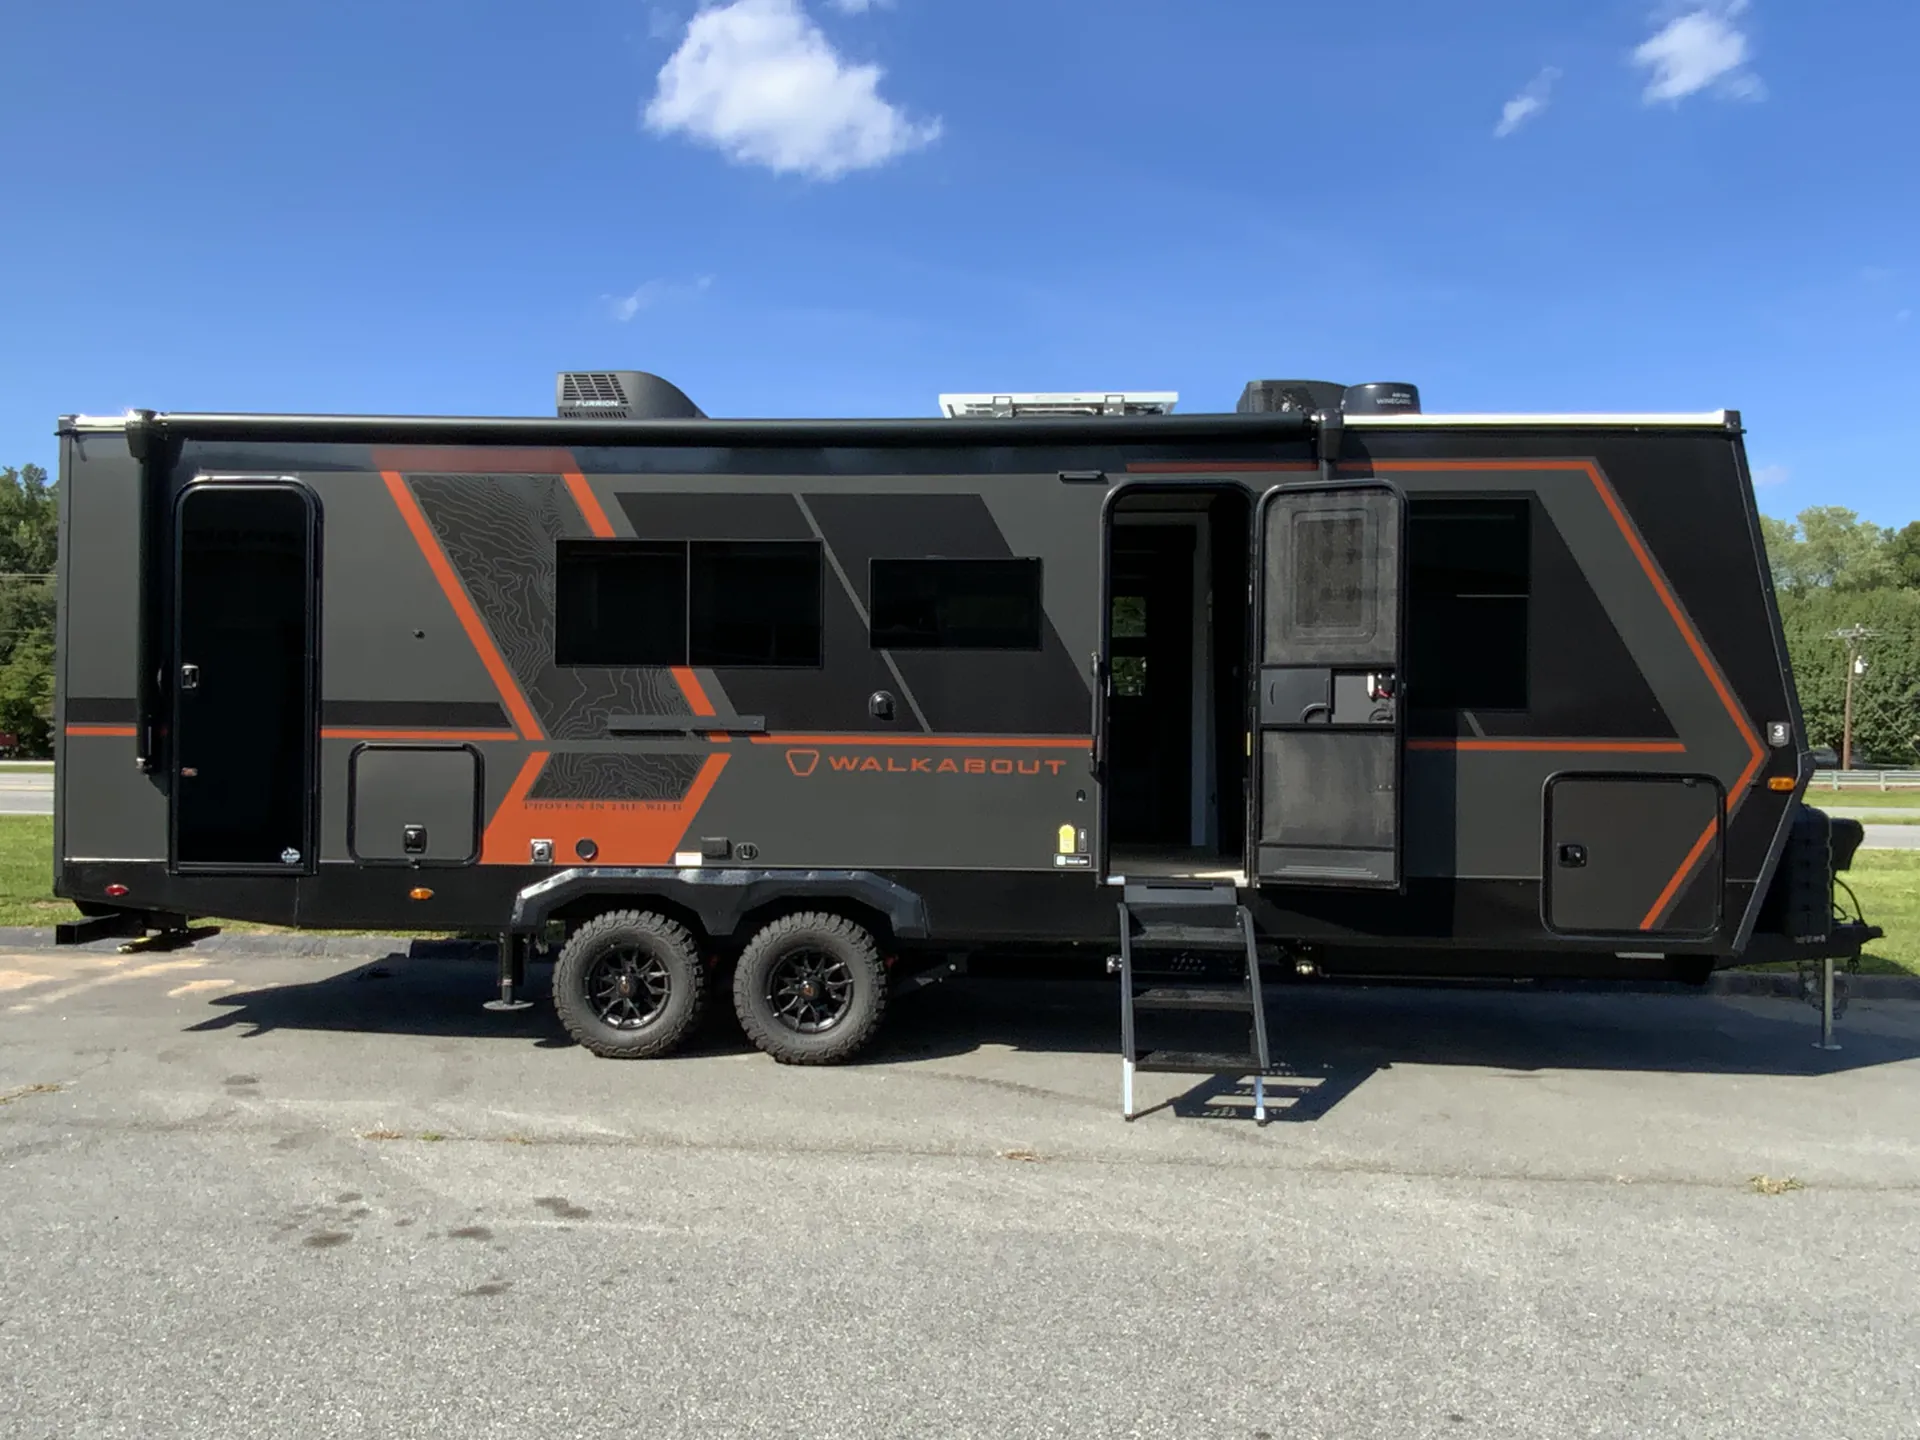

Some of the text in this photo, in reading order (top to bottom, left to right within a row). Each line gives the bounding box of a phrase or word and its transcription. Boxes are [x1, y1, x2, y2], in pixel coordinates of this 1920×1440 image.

[1773, 725, 1784, 736] 3
[828, 755, 1067, 776] WALKABOUT
[590, 802, 605, 810] IN
